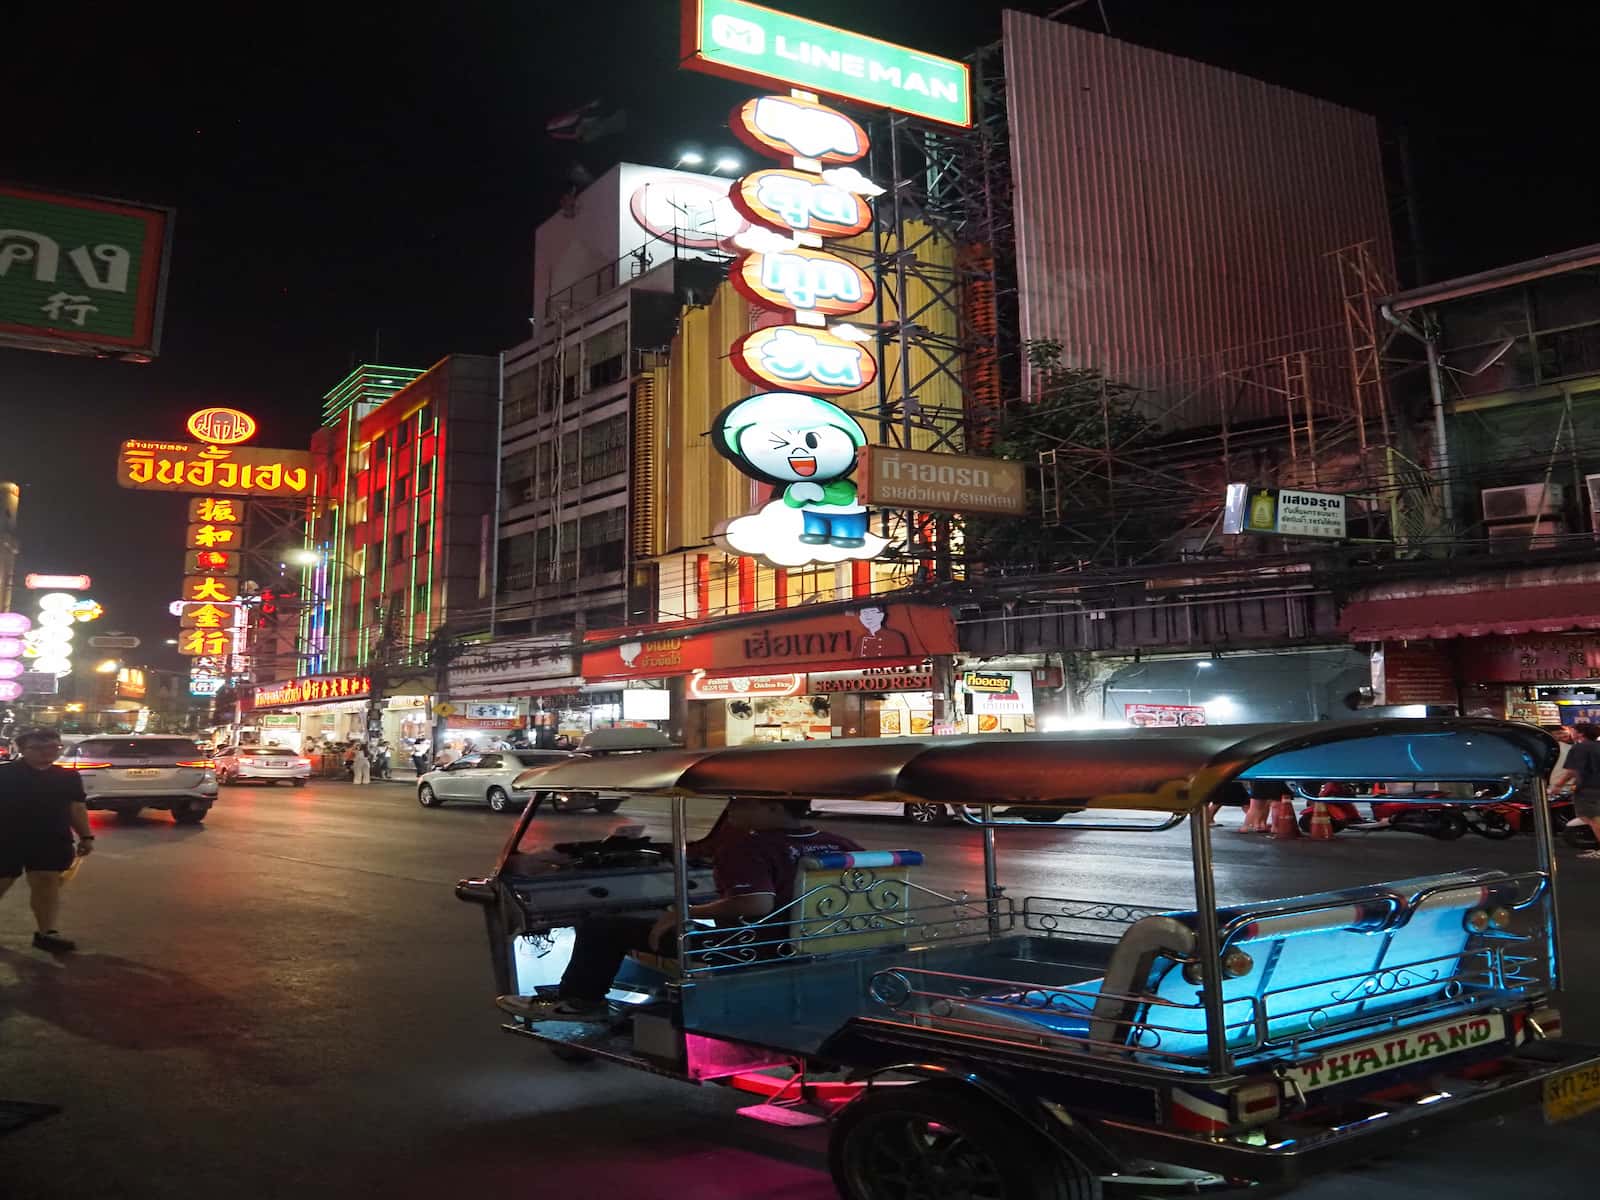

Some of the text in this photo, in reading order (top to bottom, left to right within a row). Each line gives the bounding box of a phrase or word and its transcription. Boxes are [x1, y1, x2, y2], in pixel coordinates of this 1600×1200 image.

[775, 35, 958, 103] LINE MAN
[41, 292, 98, 326] 行
[124, 445, 307, 491] จินฮั้วเฮง
[882, 453, 990, 488] ที่จอดรถ
[1282, 495, 1340, 511] แสงอรุณ
[815, 675, 887, 692] SEAFOOD
[1302, 1018, 1491, 1087] THAILAND
